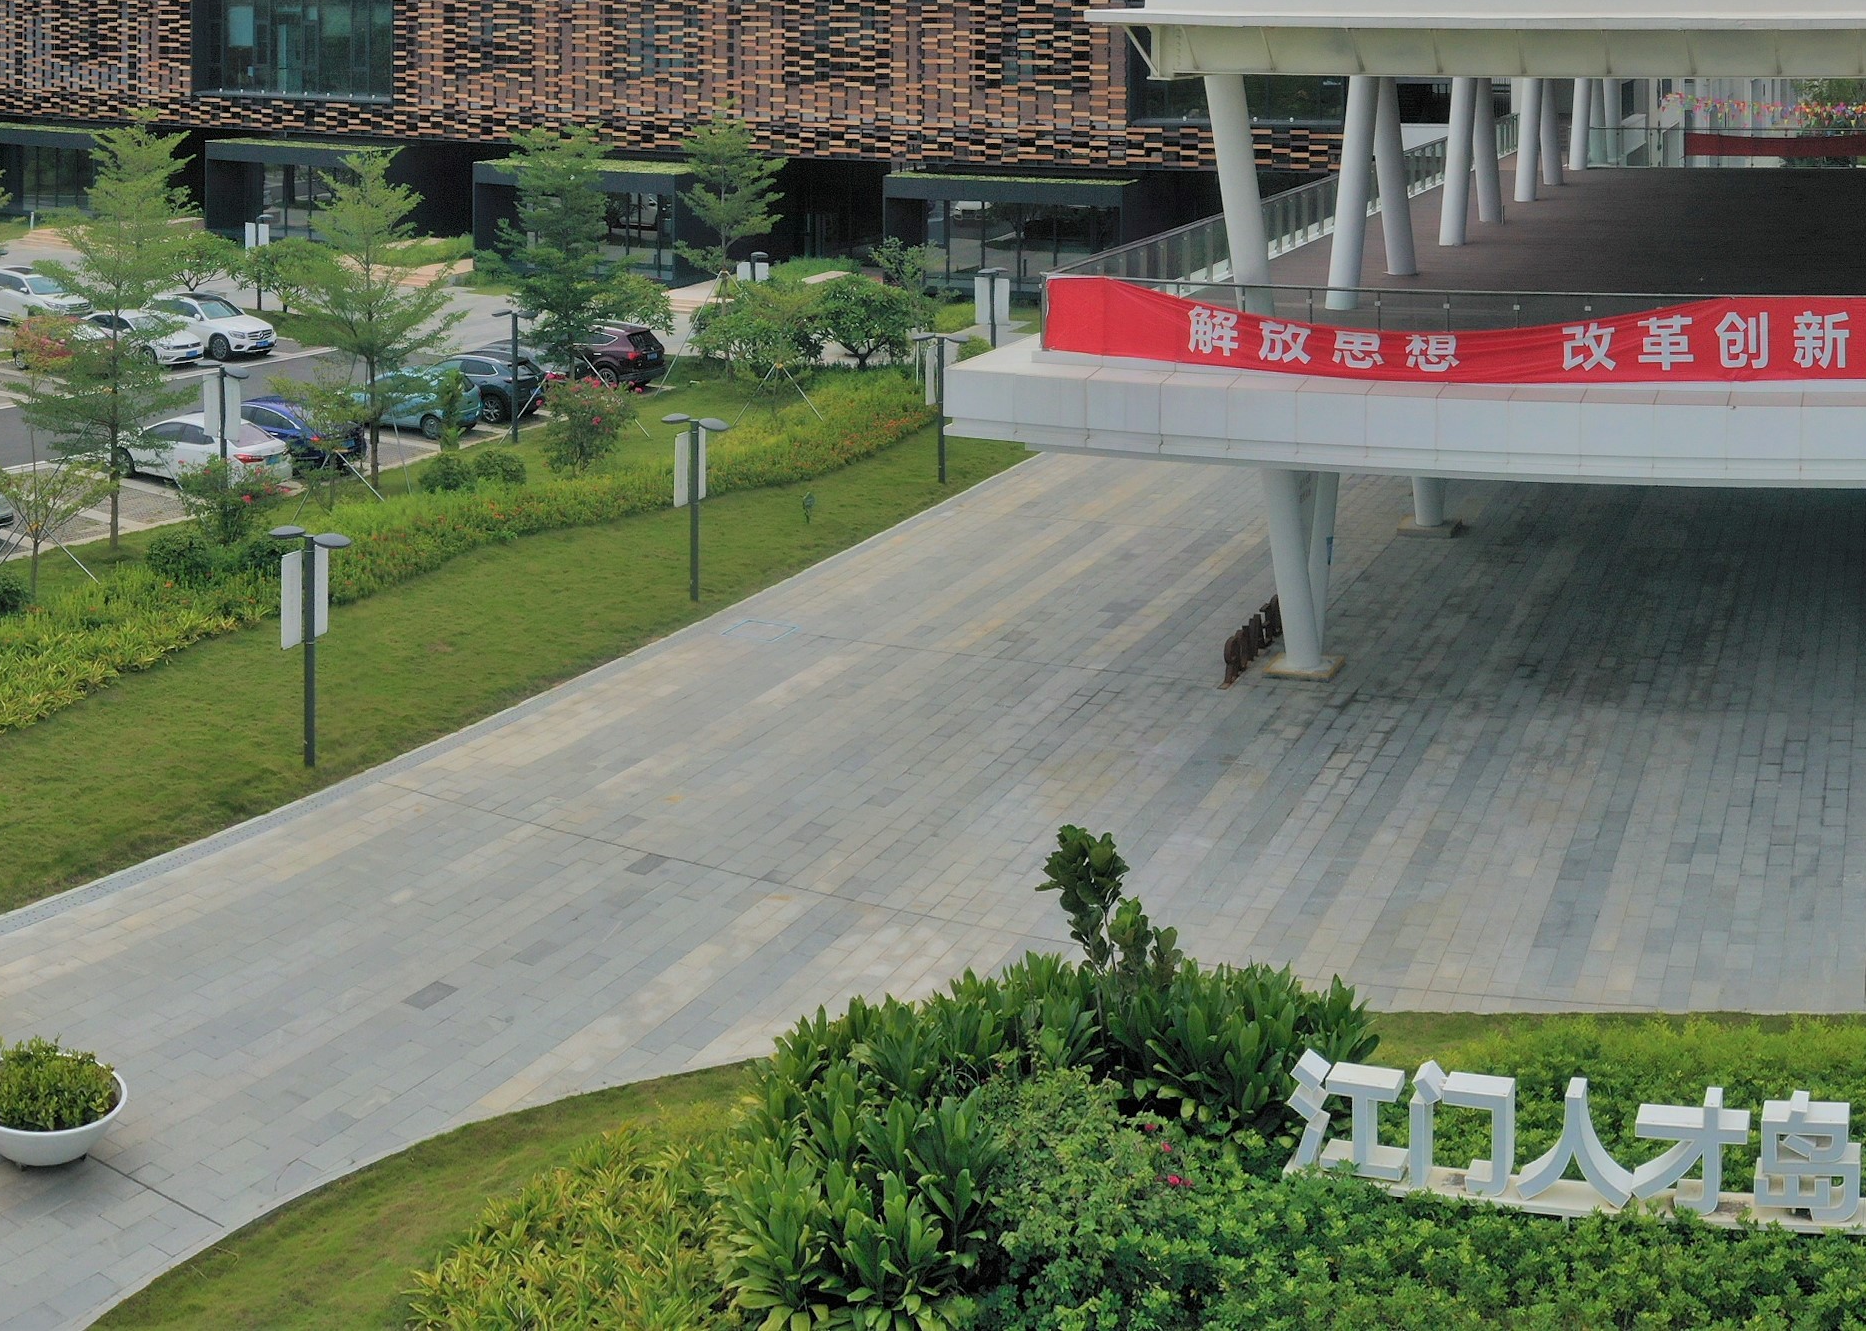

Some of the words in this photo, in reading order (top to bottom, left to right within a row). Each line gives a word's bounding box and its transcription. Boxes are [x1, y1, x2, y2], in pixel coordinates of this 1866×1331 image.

[1186, 305, 1461, 374] 解放思想
[1561, 309, 1852, 372] 改革创新
